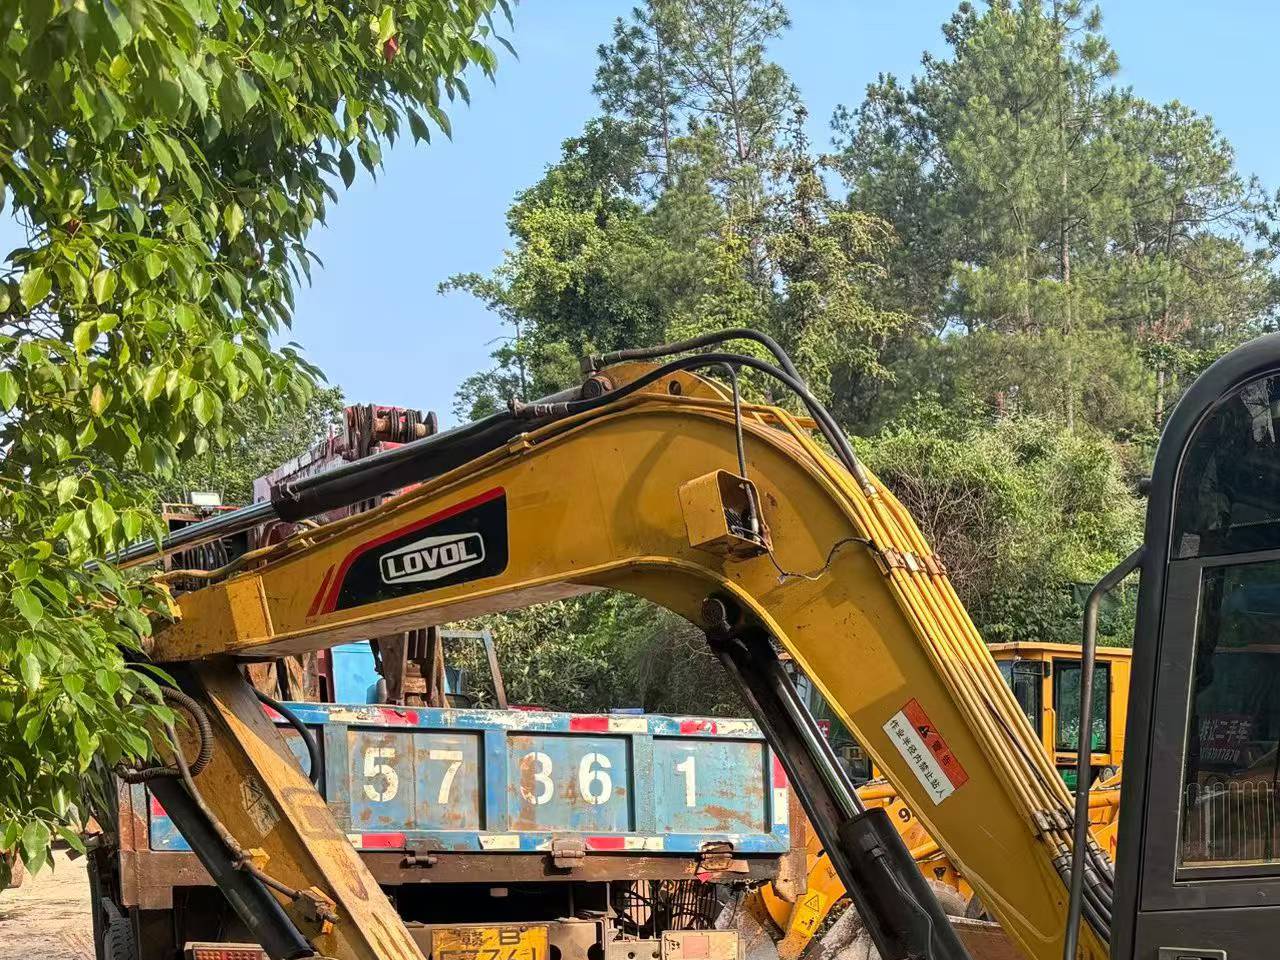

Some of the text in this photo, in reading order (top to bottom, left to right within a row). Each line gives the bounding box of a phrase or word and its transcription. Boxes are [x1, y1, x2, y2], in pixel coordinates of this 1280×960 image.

[386, 540, 478, 579] LOVOL
[890, 719, 946, 799] 作业半径内禁止站人
